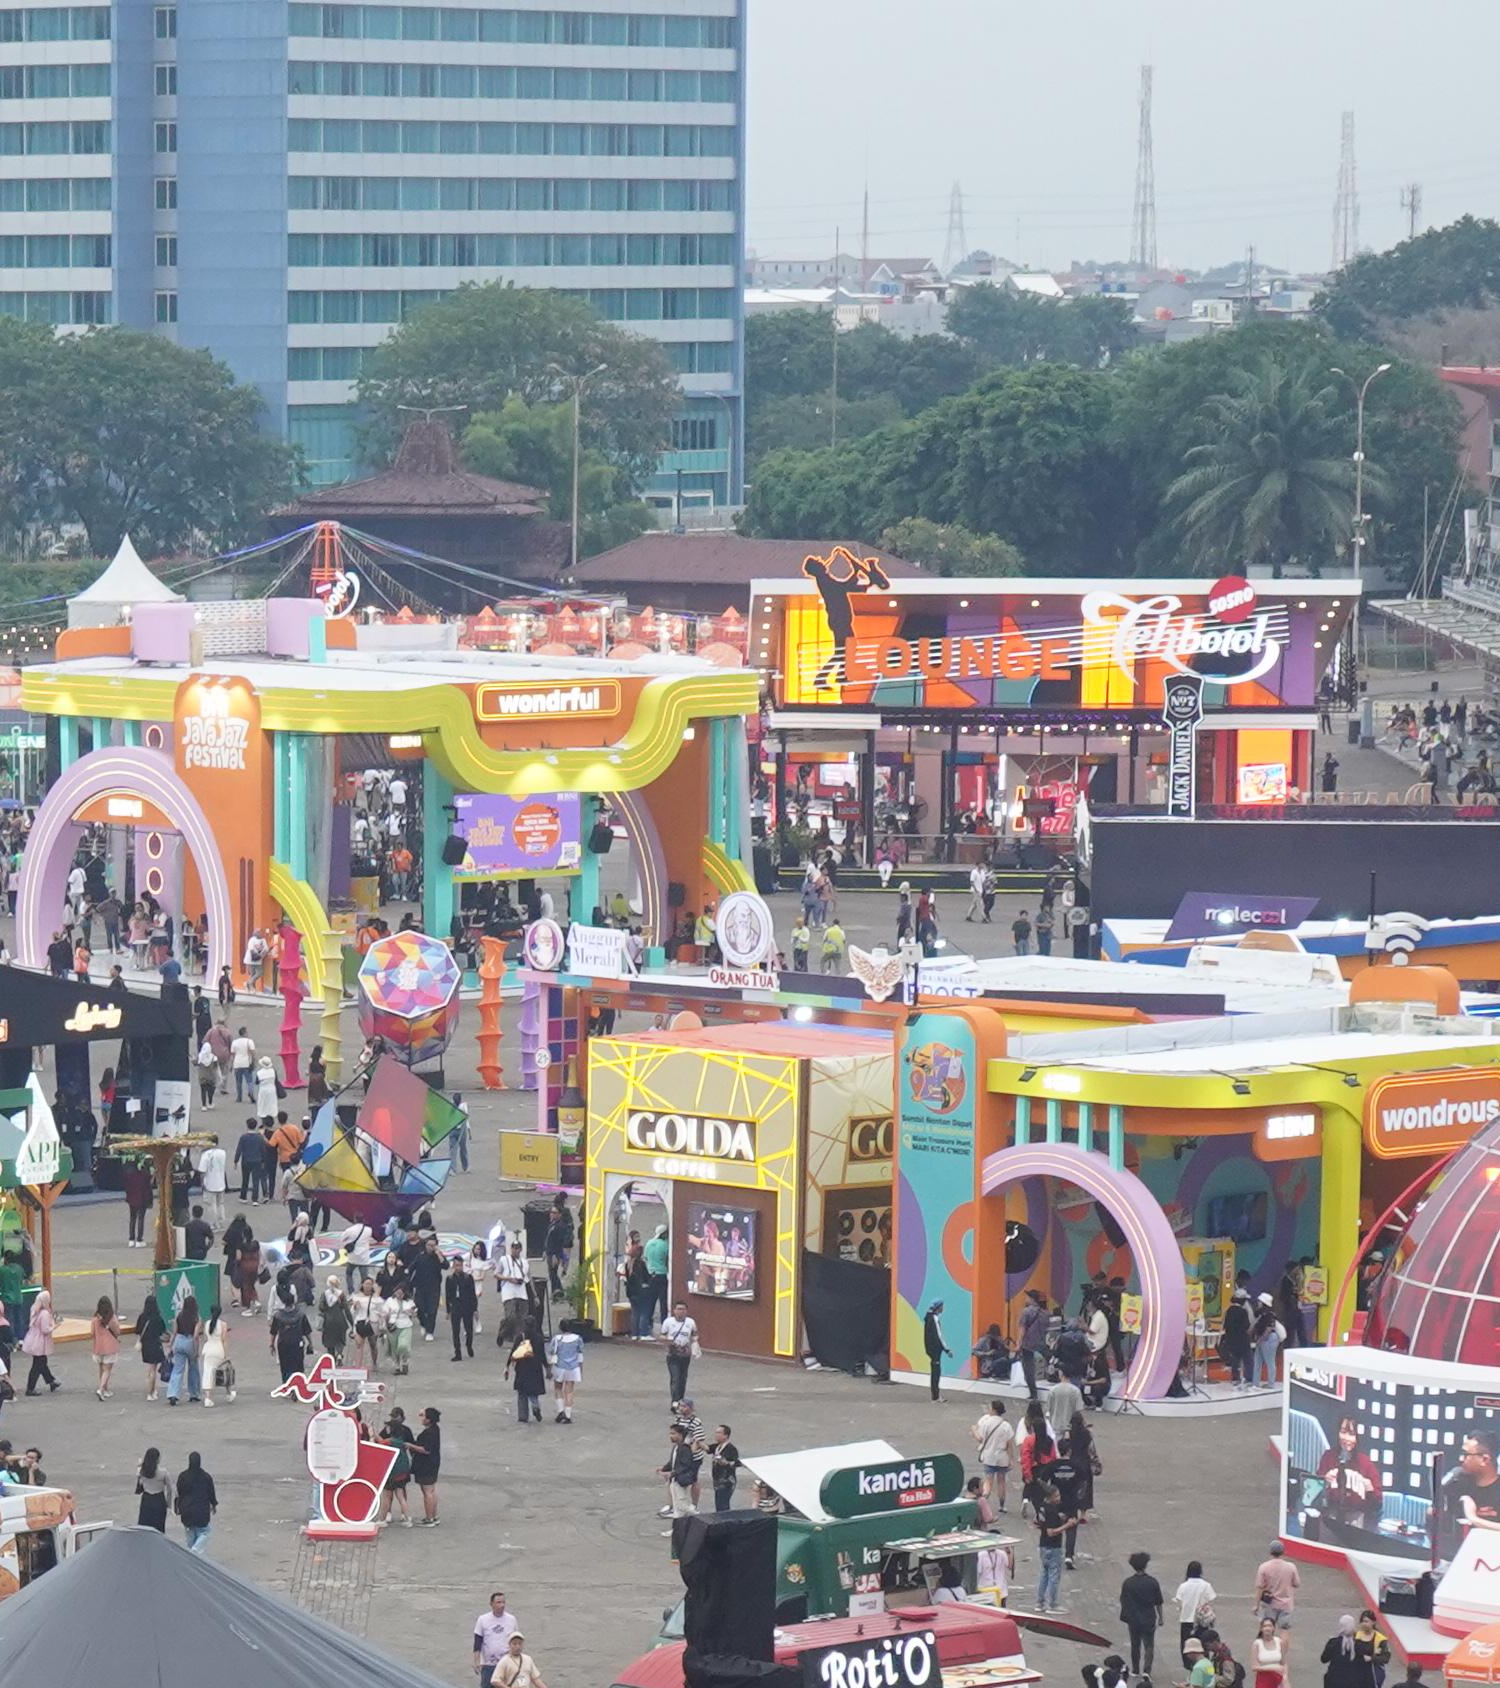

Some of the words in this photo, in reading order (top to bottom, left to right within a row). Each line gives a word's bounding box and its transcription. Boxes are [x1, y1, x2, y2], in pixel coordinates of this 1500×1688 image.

[1208, 587, 1254, 616] SOSRO
[845, 636, 1072, 682] LOUNGE
[499, 687, 599, 714] wondrful
[1177, 774, 1190, 811] JACK
[1383, 1096, 1500, 1132] wondrous
[628, 1111, 755, 1161] GOLDA
